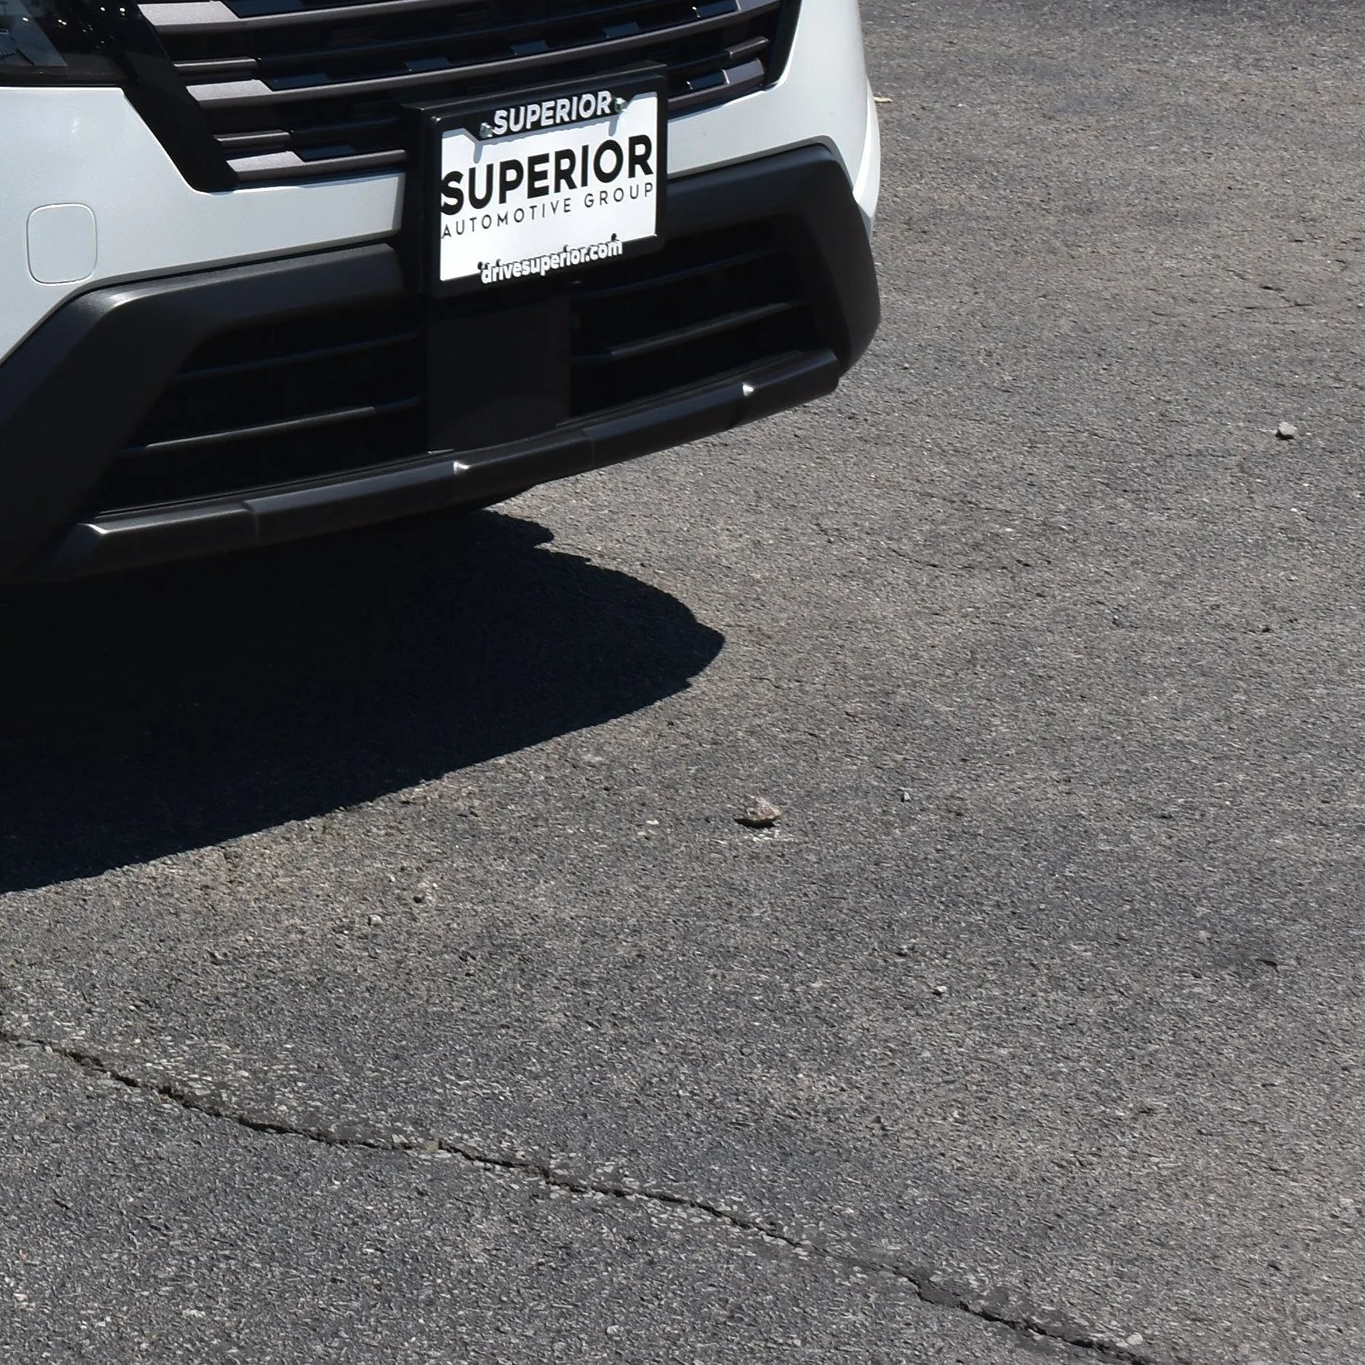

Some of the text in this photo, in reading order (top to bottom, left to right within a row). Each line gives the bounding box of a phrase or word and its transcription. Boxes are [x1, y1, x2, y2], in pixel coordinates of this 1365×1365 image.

[491, 90, 613, 135] SUPERIOR
[440, 134, 654, 216] SUPERIOR
[441, 182, 654, 239] AUTOMOTIVE GROUP
[480, 238, 624, 284] drivesuperior.com
